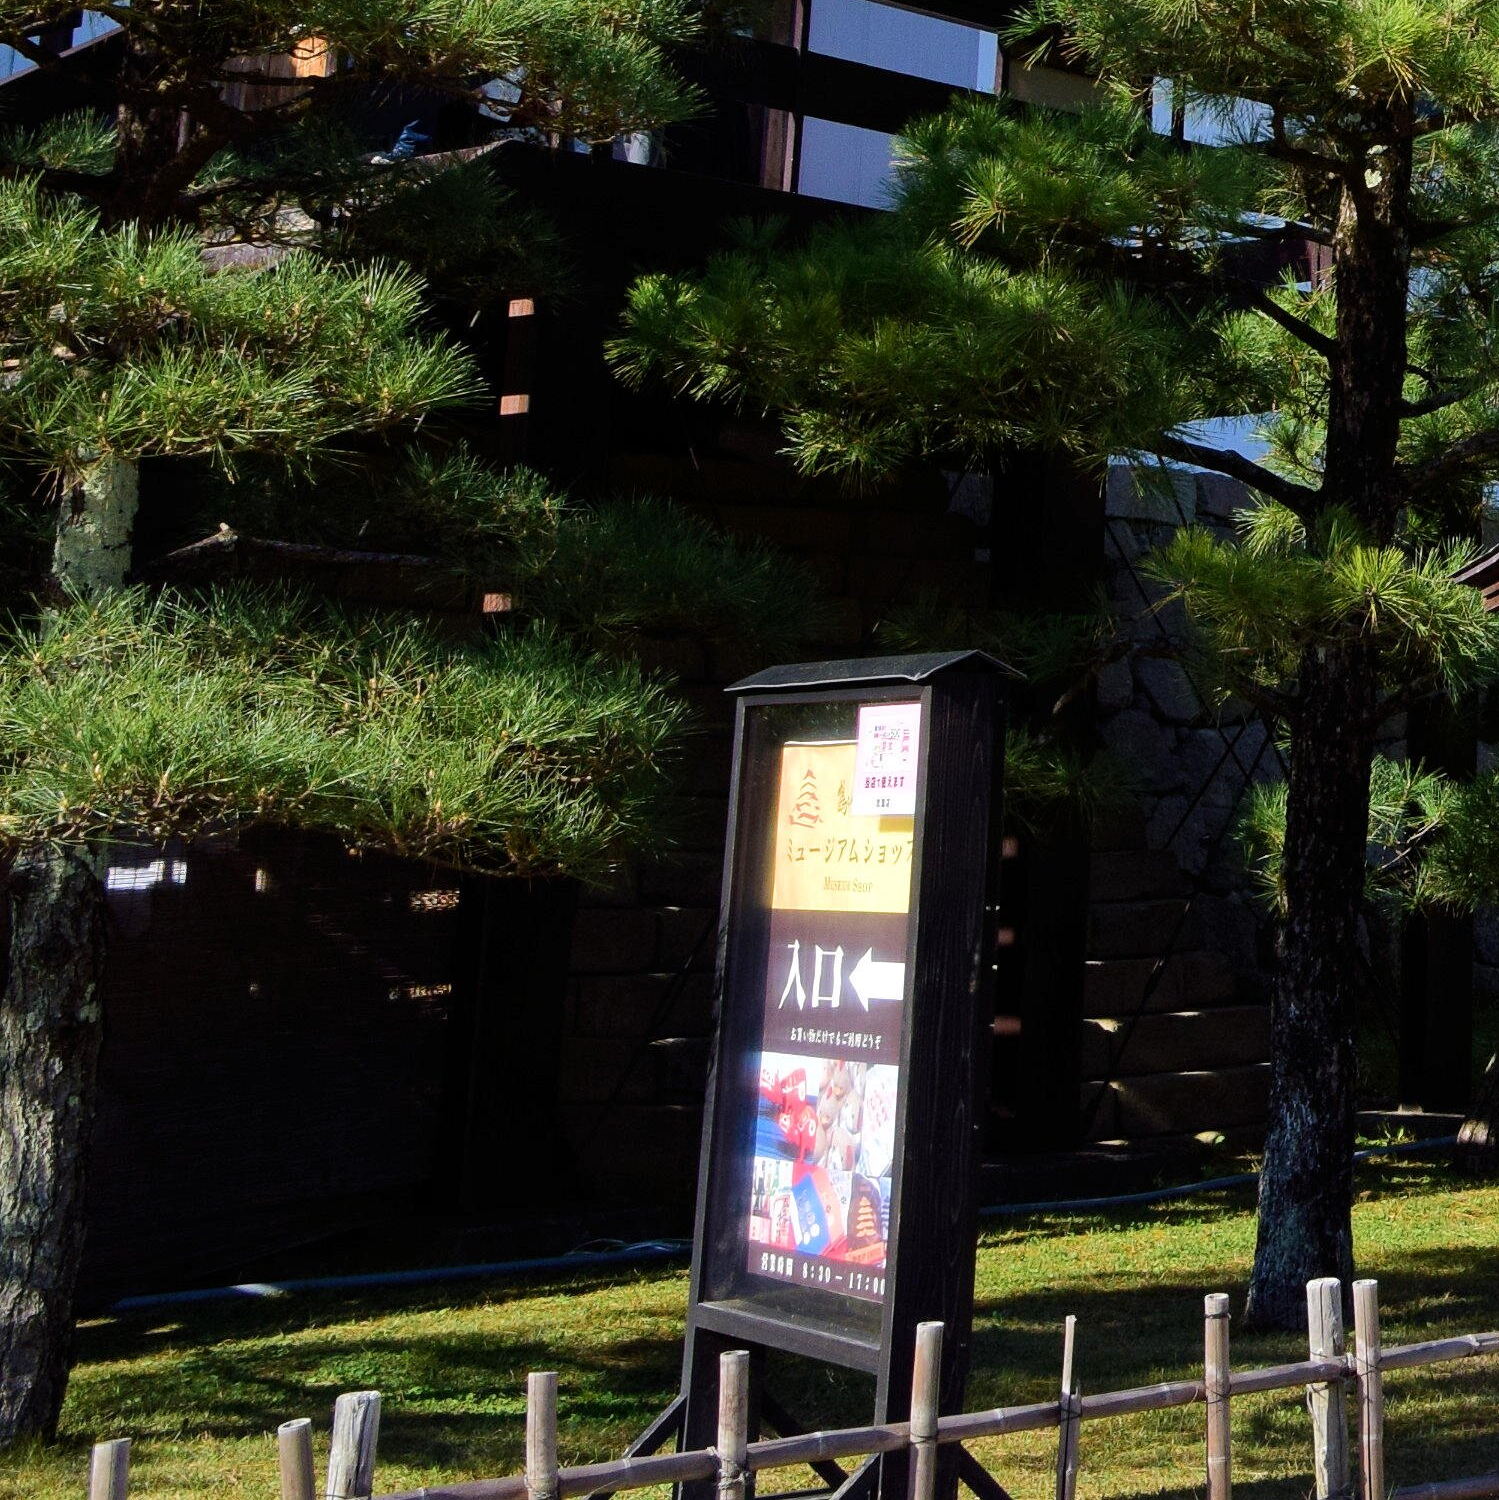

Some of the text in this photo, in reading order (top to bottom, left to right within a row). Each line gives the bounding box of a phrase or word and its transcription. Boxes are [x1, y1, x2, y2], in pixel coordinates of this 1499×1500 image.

[778, 939, 844, 1011] 入口
[761, 1251, 794, 1277] 営業時間
